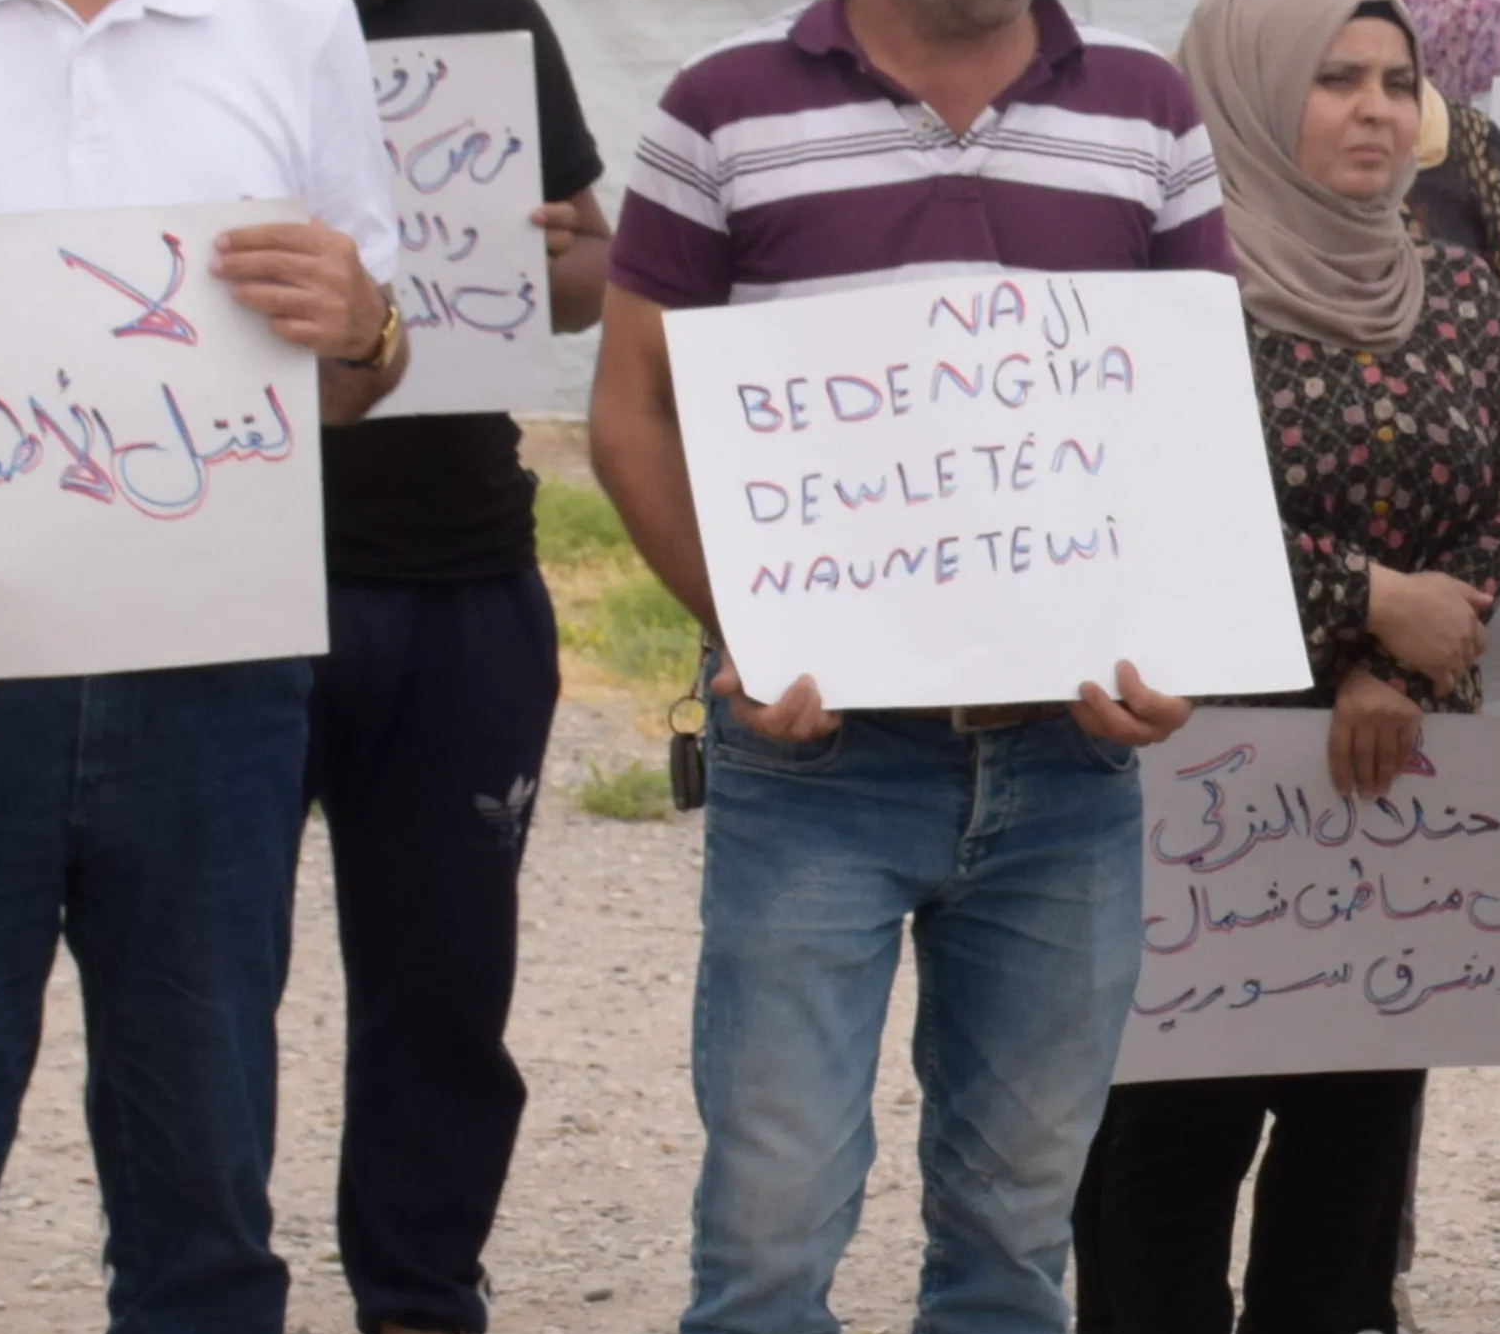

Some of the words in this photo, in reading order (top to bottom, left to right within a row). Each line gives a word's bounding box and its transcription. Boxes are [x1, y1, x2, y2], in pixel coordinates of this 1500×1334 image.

[57, 231, 199, 346] لا
[451, 272, 537, 342] في
[111, 383, 294, 522] لقتل
[1150, 742, 1312, 873] التركي
[1141, 882, 1289, 955] شمال
[1293, 856, 1463, 929] مناطق
[1132, 962, 1353, 1032] سوري
